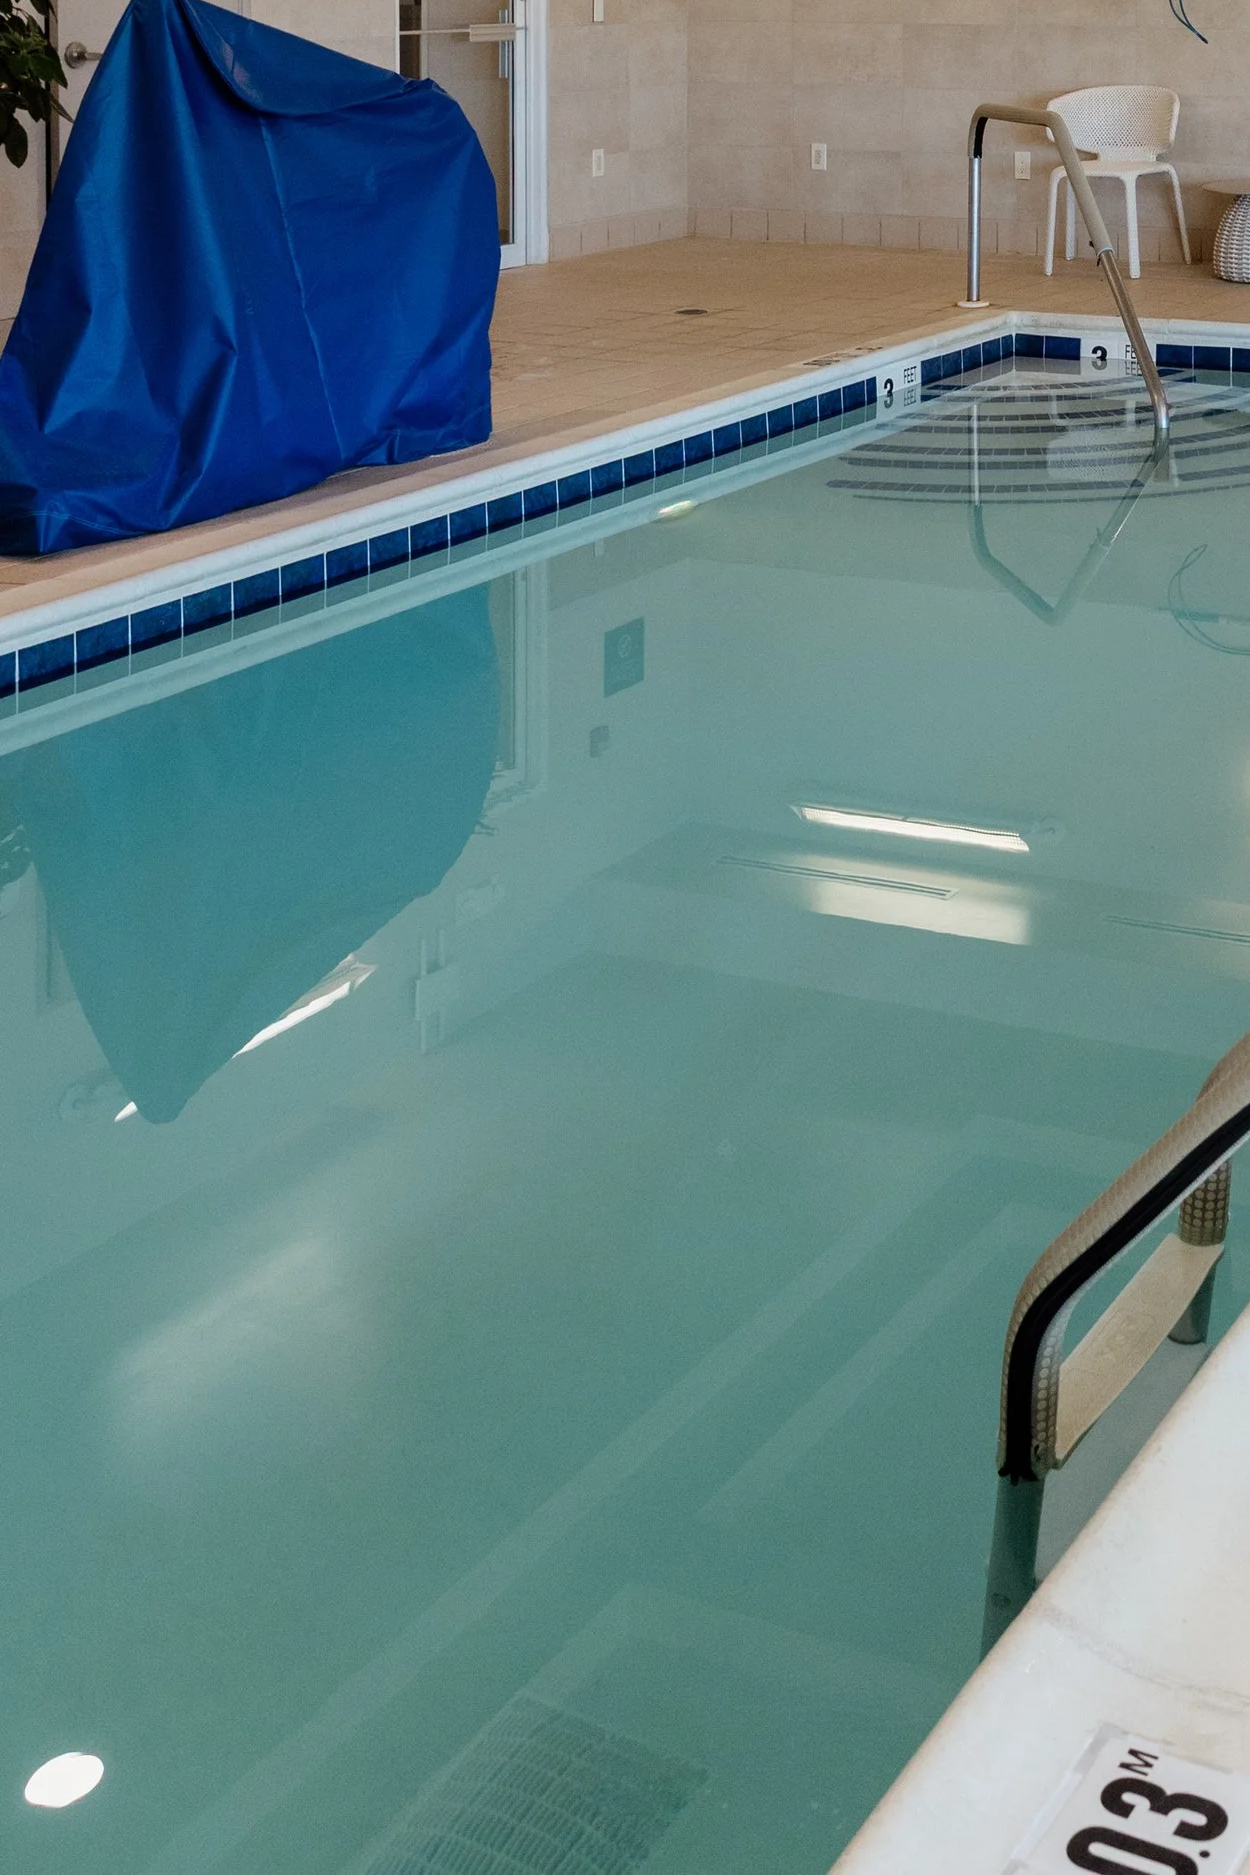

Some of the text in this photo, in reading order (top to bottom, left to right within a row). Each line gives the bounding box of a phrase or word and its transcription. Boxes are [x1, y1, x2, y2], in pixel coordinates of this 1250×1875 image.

[1092, 345, 1137, 366] 3 FE
[884, 366, 917, 404] 3 FEET
